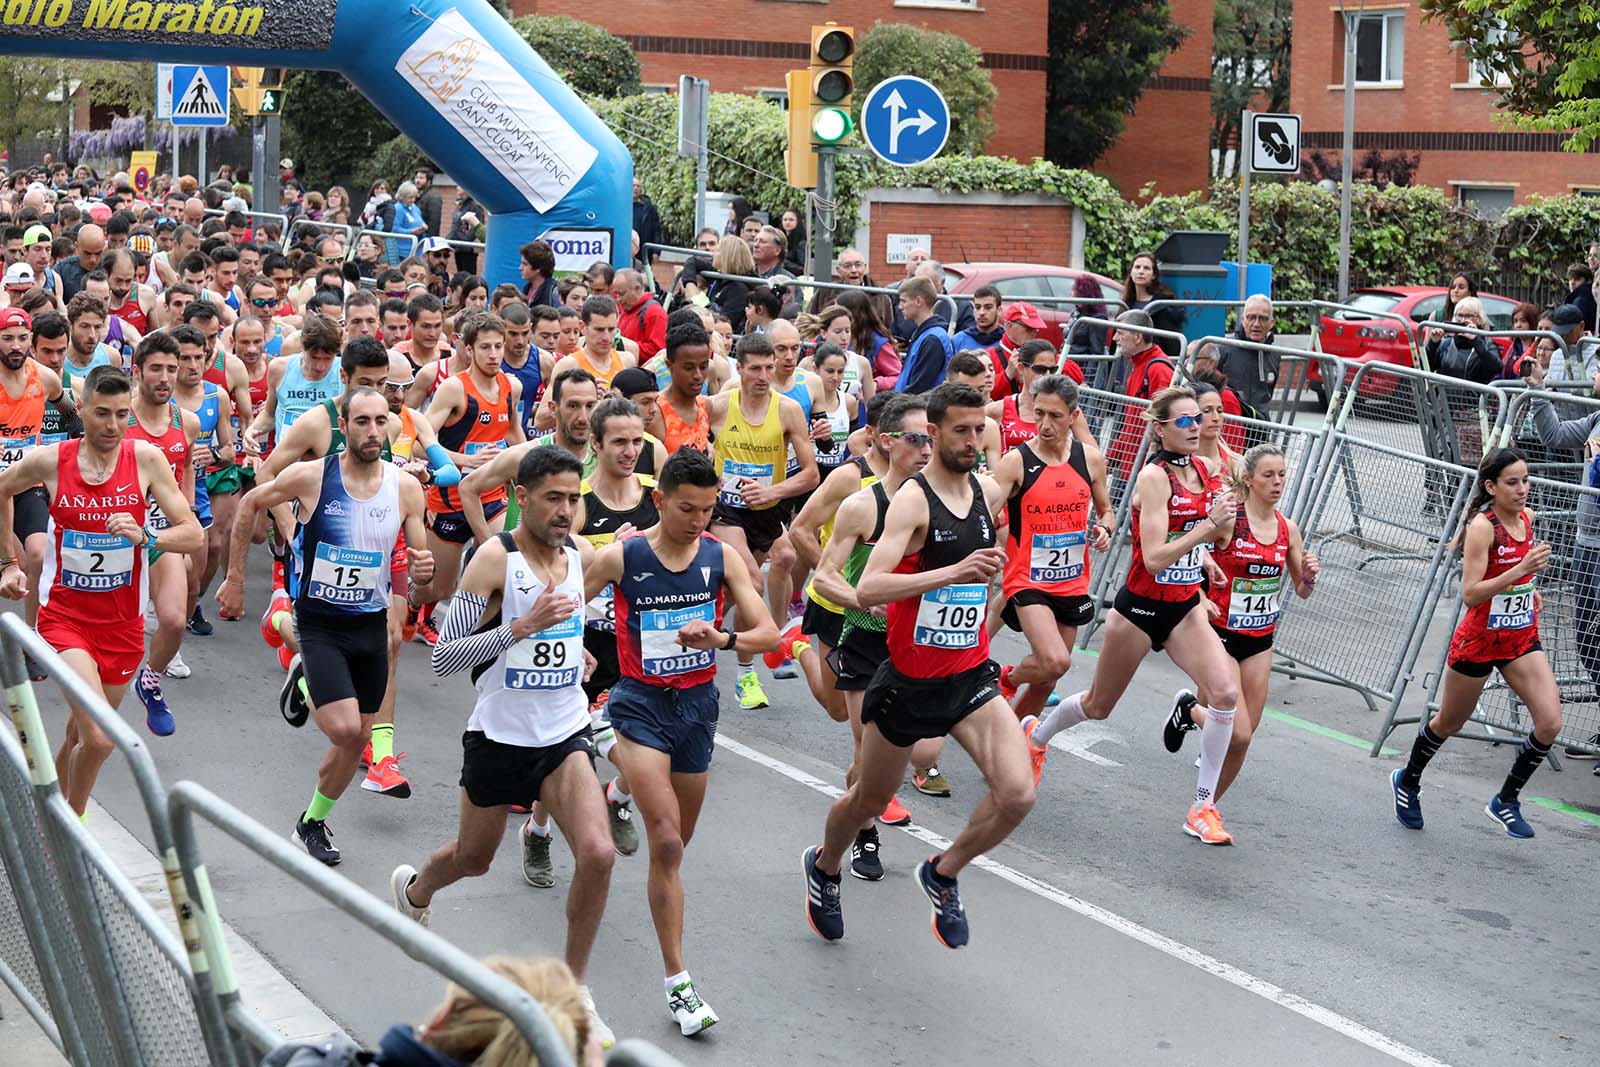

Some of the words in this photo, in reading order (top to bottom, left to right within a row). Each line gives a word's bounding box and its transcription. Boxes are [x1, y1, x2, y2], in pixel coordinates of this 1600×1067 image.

[0, 0, 71, 27] dio
[456, 98, 488, 130] SANT
[486, 127, 525, 163] CUGAT
[470, 86, 498, 117] CLUB
[496, 112, 571, 187] MUNTANYENC
[545, 239, 604, 255] oma
[287, 388, 327, 401] nerja
[58, 494, 139, 508] AÑARES
[89, 553, 104, 573] 2
[1048, 549, 1069, 567] 21
[67, 572, 124, 588] Joma
[334, 567, 361, 587] 15
[1035, 567, 1079, 581] Joma
[316, 584, 366, 601] Joma
[636, 591, 711, 605] A.D.MARATHON
[1503, 593, 1530, 613] 130
[936, 606, 978, 628] 109
[1233, 614, 1275, 628] Joma
[921, 629, 975, 646] Joma
[533, 642, 566, 668] 89
[651, 651, 711, 675] Joma
[512, 671, 573, 688] Joma
